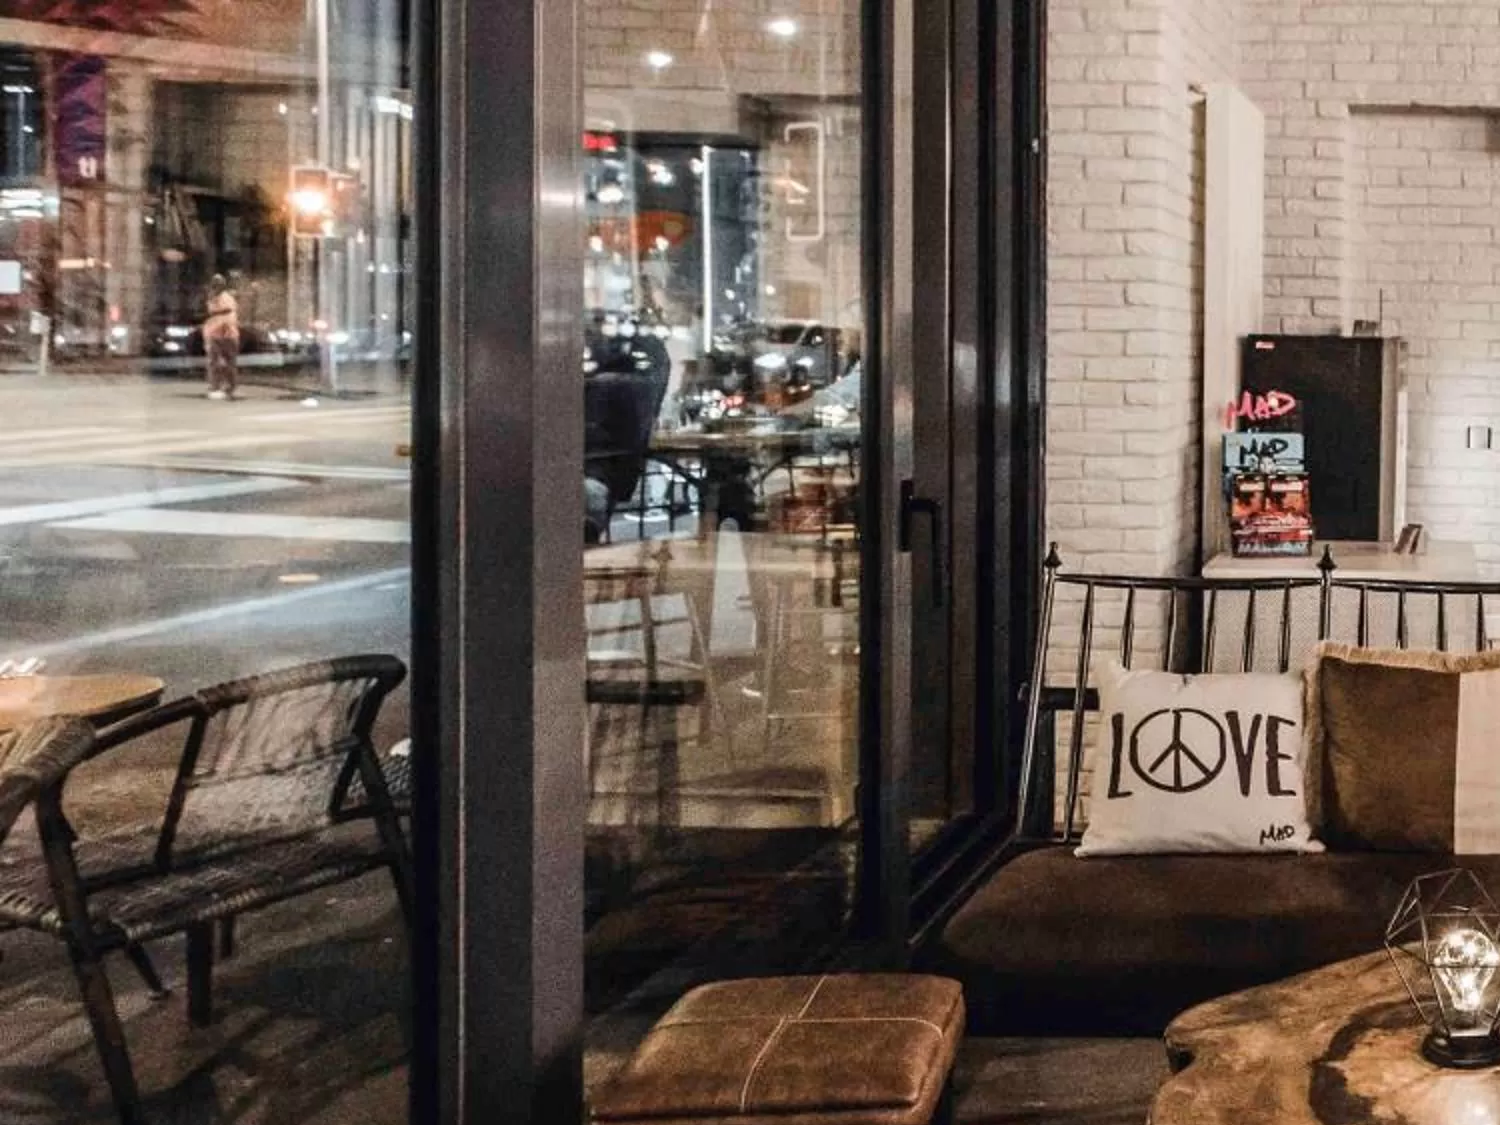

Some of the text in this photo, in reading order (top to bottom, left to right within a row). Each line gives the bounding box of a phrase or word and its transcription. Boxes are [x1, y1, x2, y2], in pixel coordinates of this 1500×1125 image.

[1222, 390, 1297, 430] MAD
[1107, 708, 1297, 799] LOVE
[1259, 824, 1295, 846] MAD
